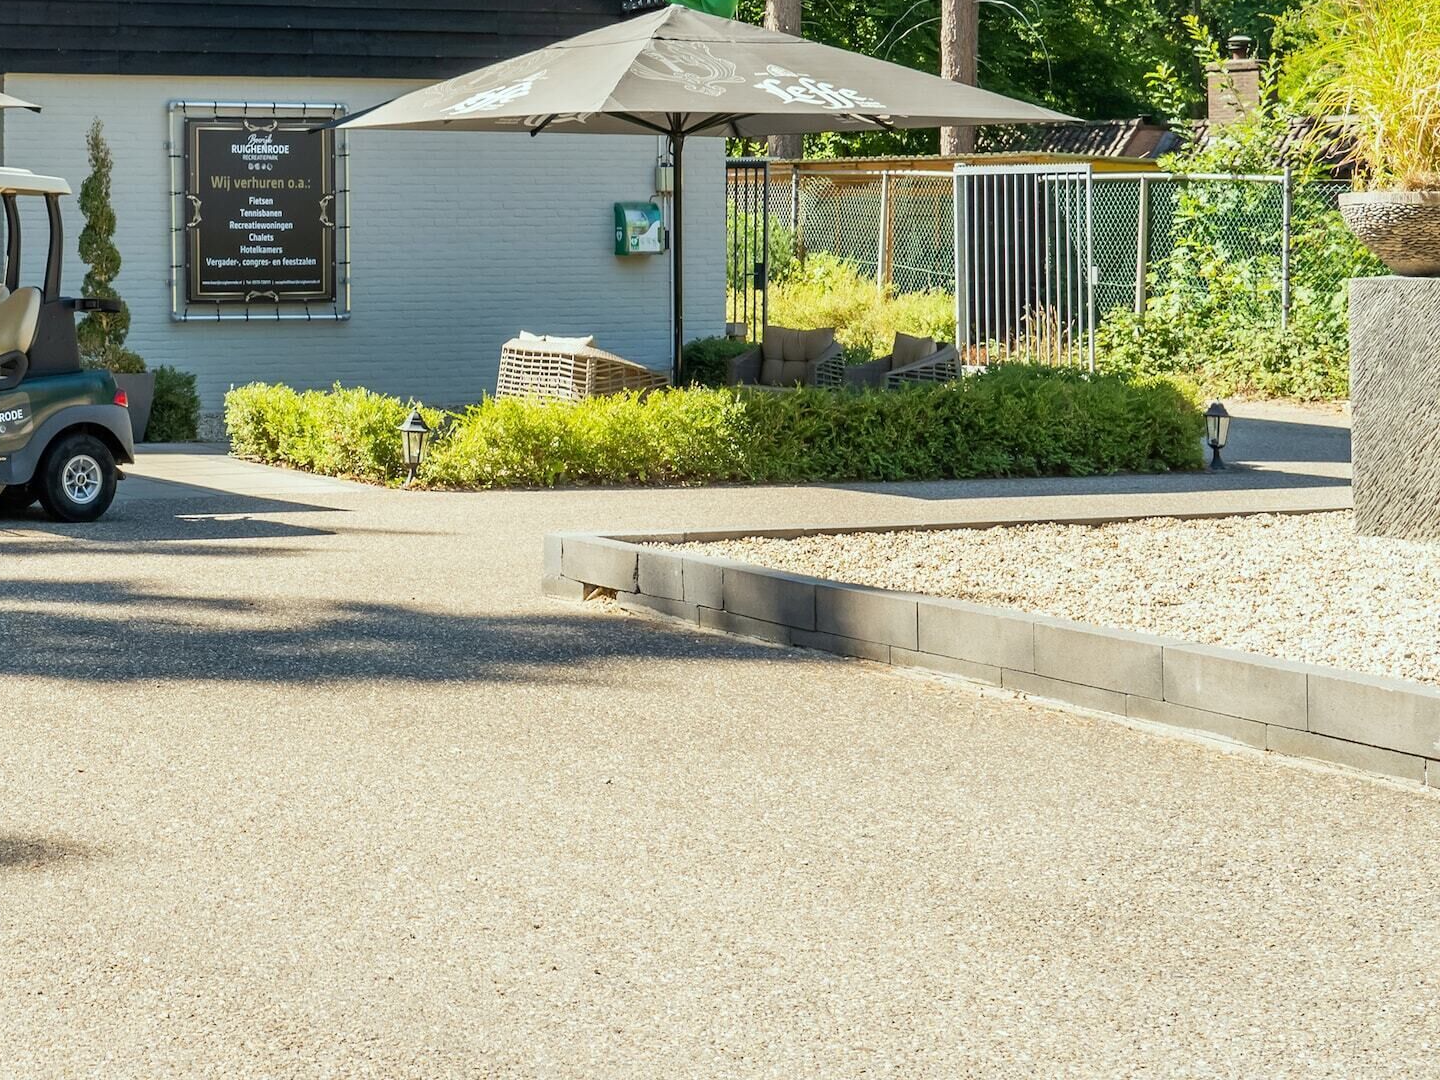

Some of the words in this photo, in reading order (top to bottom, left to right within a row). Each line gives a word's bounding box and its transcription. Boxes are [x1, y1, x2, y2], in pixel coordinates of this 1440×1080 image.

[753, 77, 867, 109] Leffe
[231, 144, 290, 154] RUIGHENRODE
[210, 175, 231, 191] Wij
[234, 176, 285, 189] verhuren
[287, 178, 311, 189] o.a.:
[248, 196, 274, 206] Fietsen
[239, 208, 283, 218] Tennisbanen
[229, 221, 294, 231] Recreatiewoningen
[248, 233, 275, 242] Chalets
[240, 245, 283, 254] Hotelkamers
[206, 257, 242, 268] Vergader-,
[242, 258, 272, 268] congres-
[282, 256, 317, 266] feestzalen
